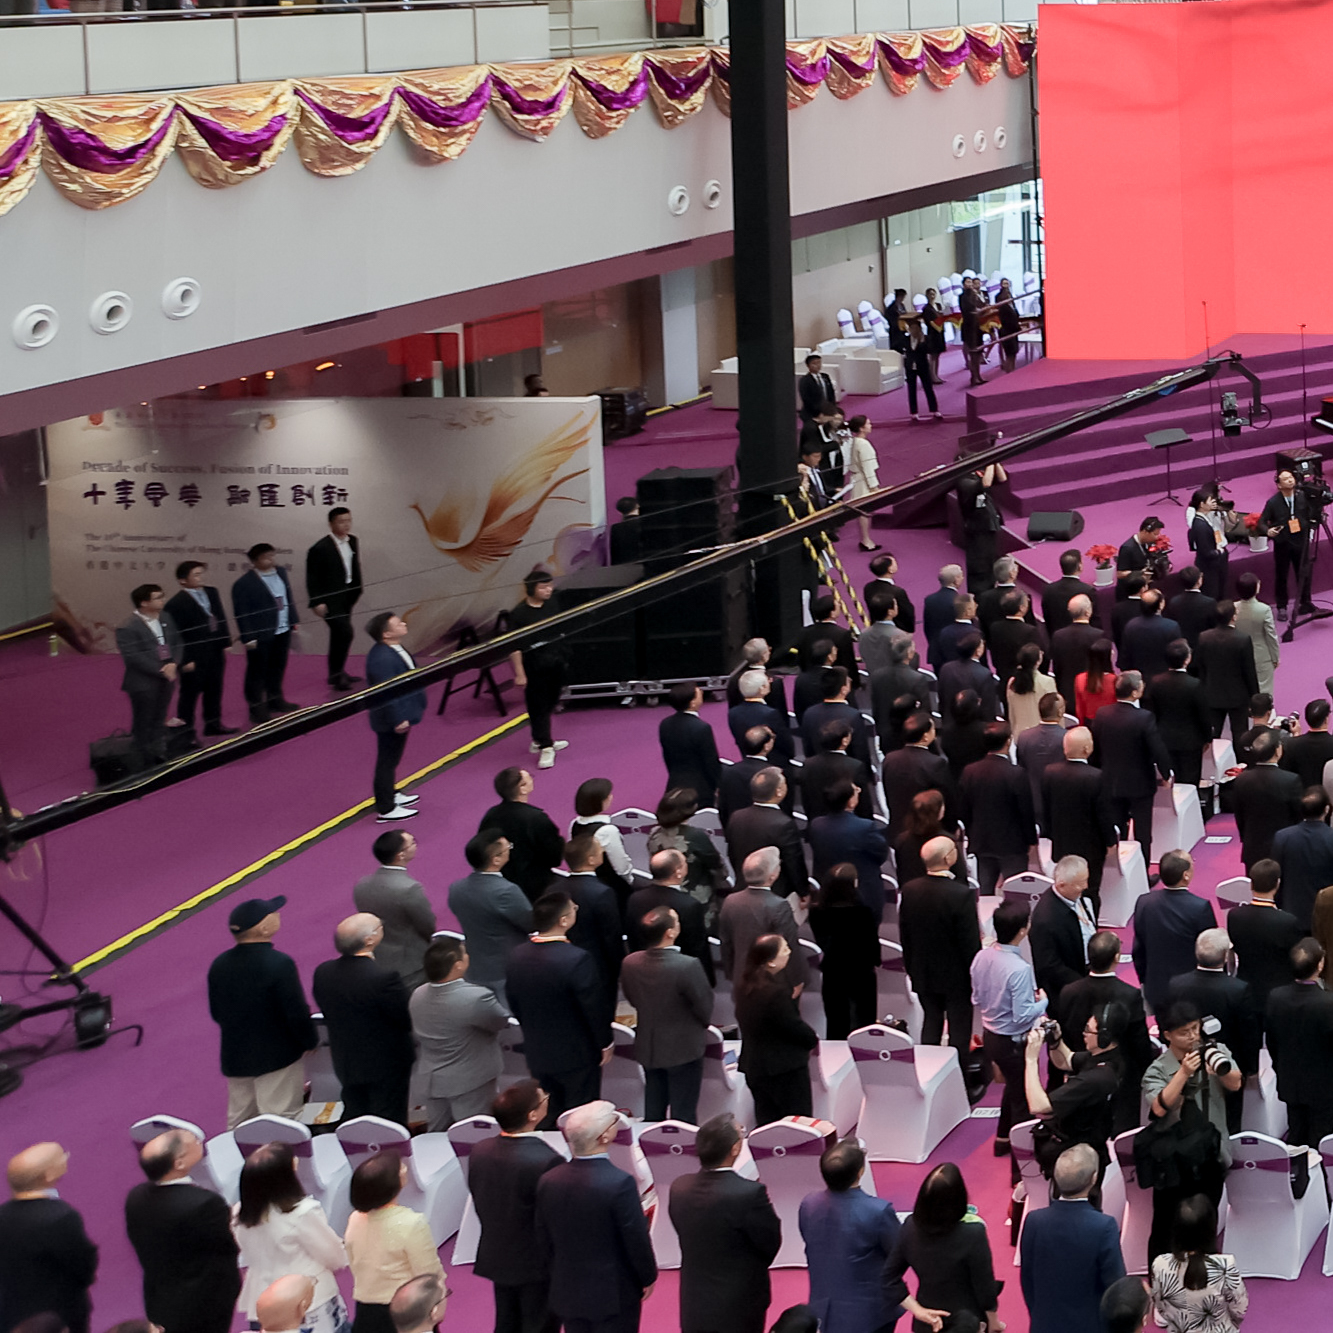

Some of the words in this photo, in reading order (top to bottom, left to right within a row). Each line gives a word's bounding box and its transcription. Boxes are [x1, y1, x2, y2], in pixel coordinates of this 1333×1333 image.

[134, 462, 149, 473] of
[258, 464, 273, 475] of
[276, 464, 349, 476] Innovation
